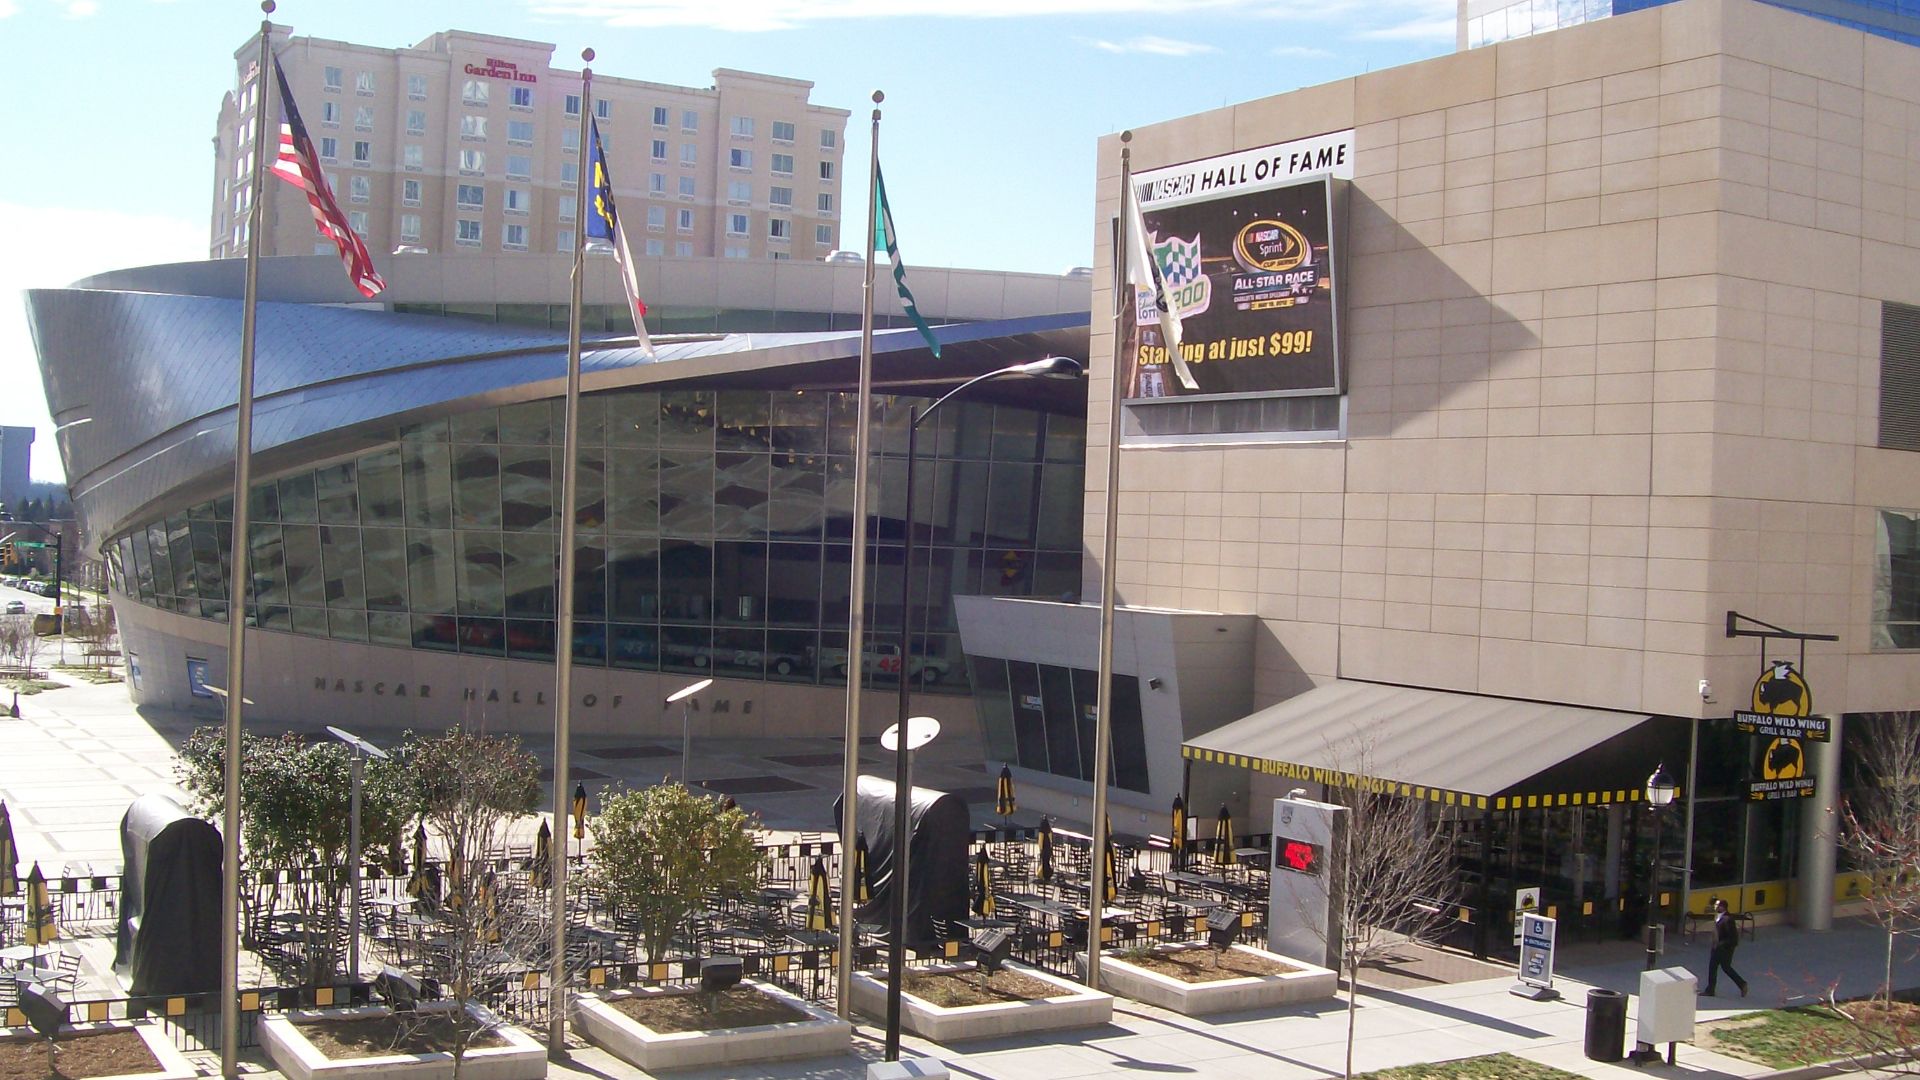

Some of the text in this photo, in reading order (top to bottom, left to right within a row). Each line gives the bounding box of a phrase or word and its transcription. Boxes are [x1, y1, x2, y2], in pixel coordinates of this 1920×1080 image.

[486, 58, 516, 69] Hilton
[464, 64, 537, 83] Garden Inn
[1149, 143, 1347, 201] NASCAR HALL OF FAME
[1253, 229, 1279, 243] NASCAR
[1260, 241, 1283, 257] Sprint
[1285, 271, 1314, 284] RACE
[1139, 330, 1313, 366] Staring at just $99!
[733, 650, 761, 666] 22
[879, 656, 901, 673] 42
[314, 677, 431, 698] NASCAR
[464, 687, 545, 705] HALL
[582, 693, 623, 709] OF
[1737, 713, 1825, 730] BUFFALO WILD WINGS
[1760, 726, 1778, 736] GRILL
[1786, 728, 1802, 737] BAR
[1261, 759, 1385, 793] BUFFALO WILD WINGS
[1751, 781, 1777, 792] BUFFALO
[1779, 780, 1794, 790] WILD
